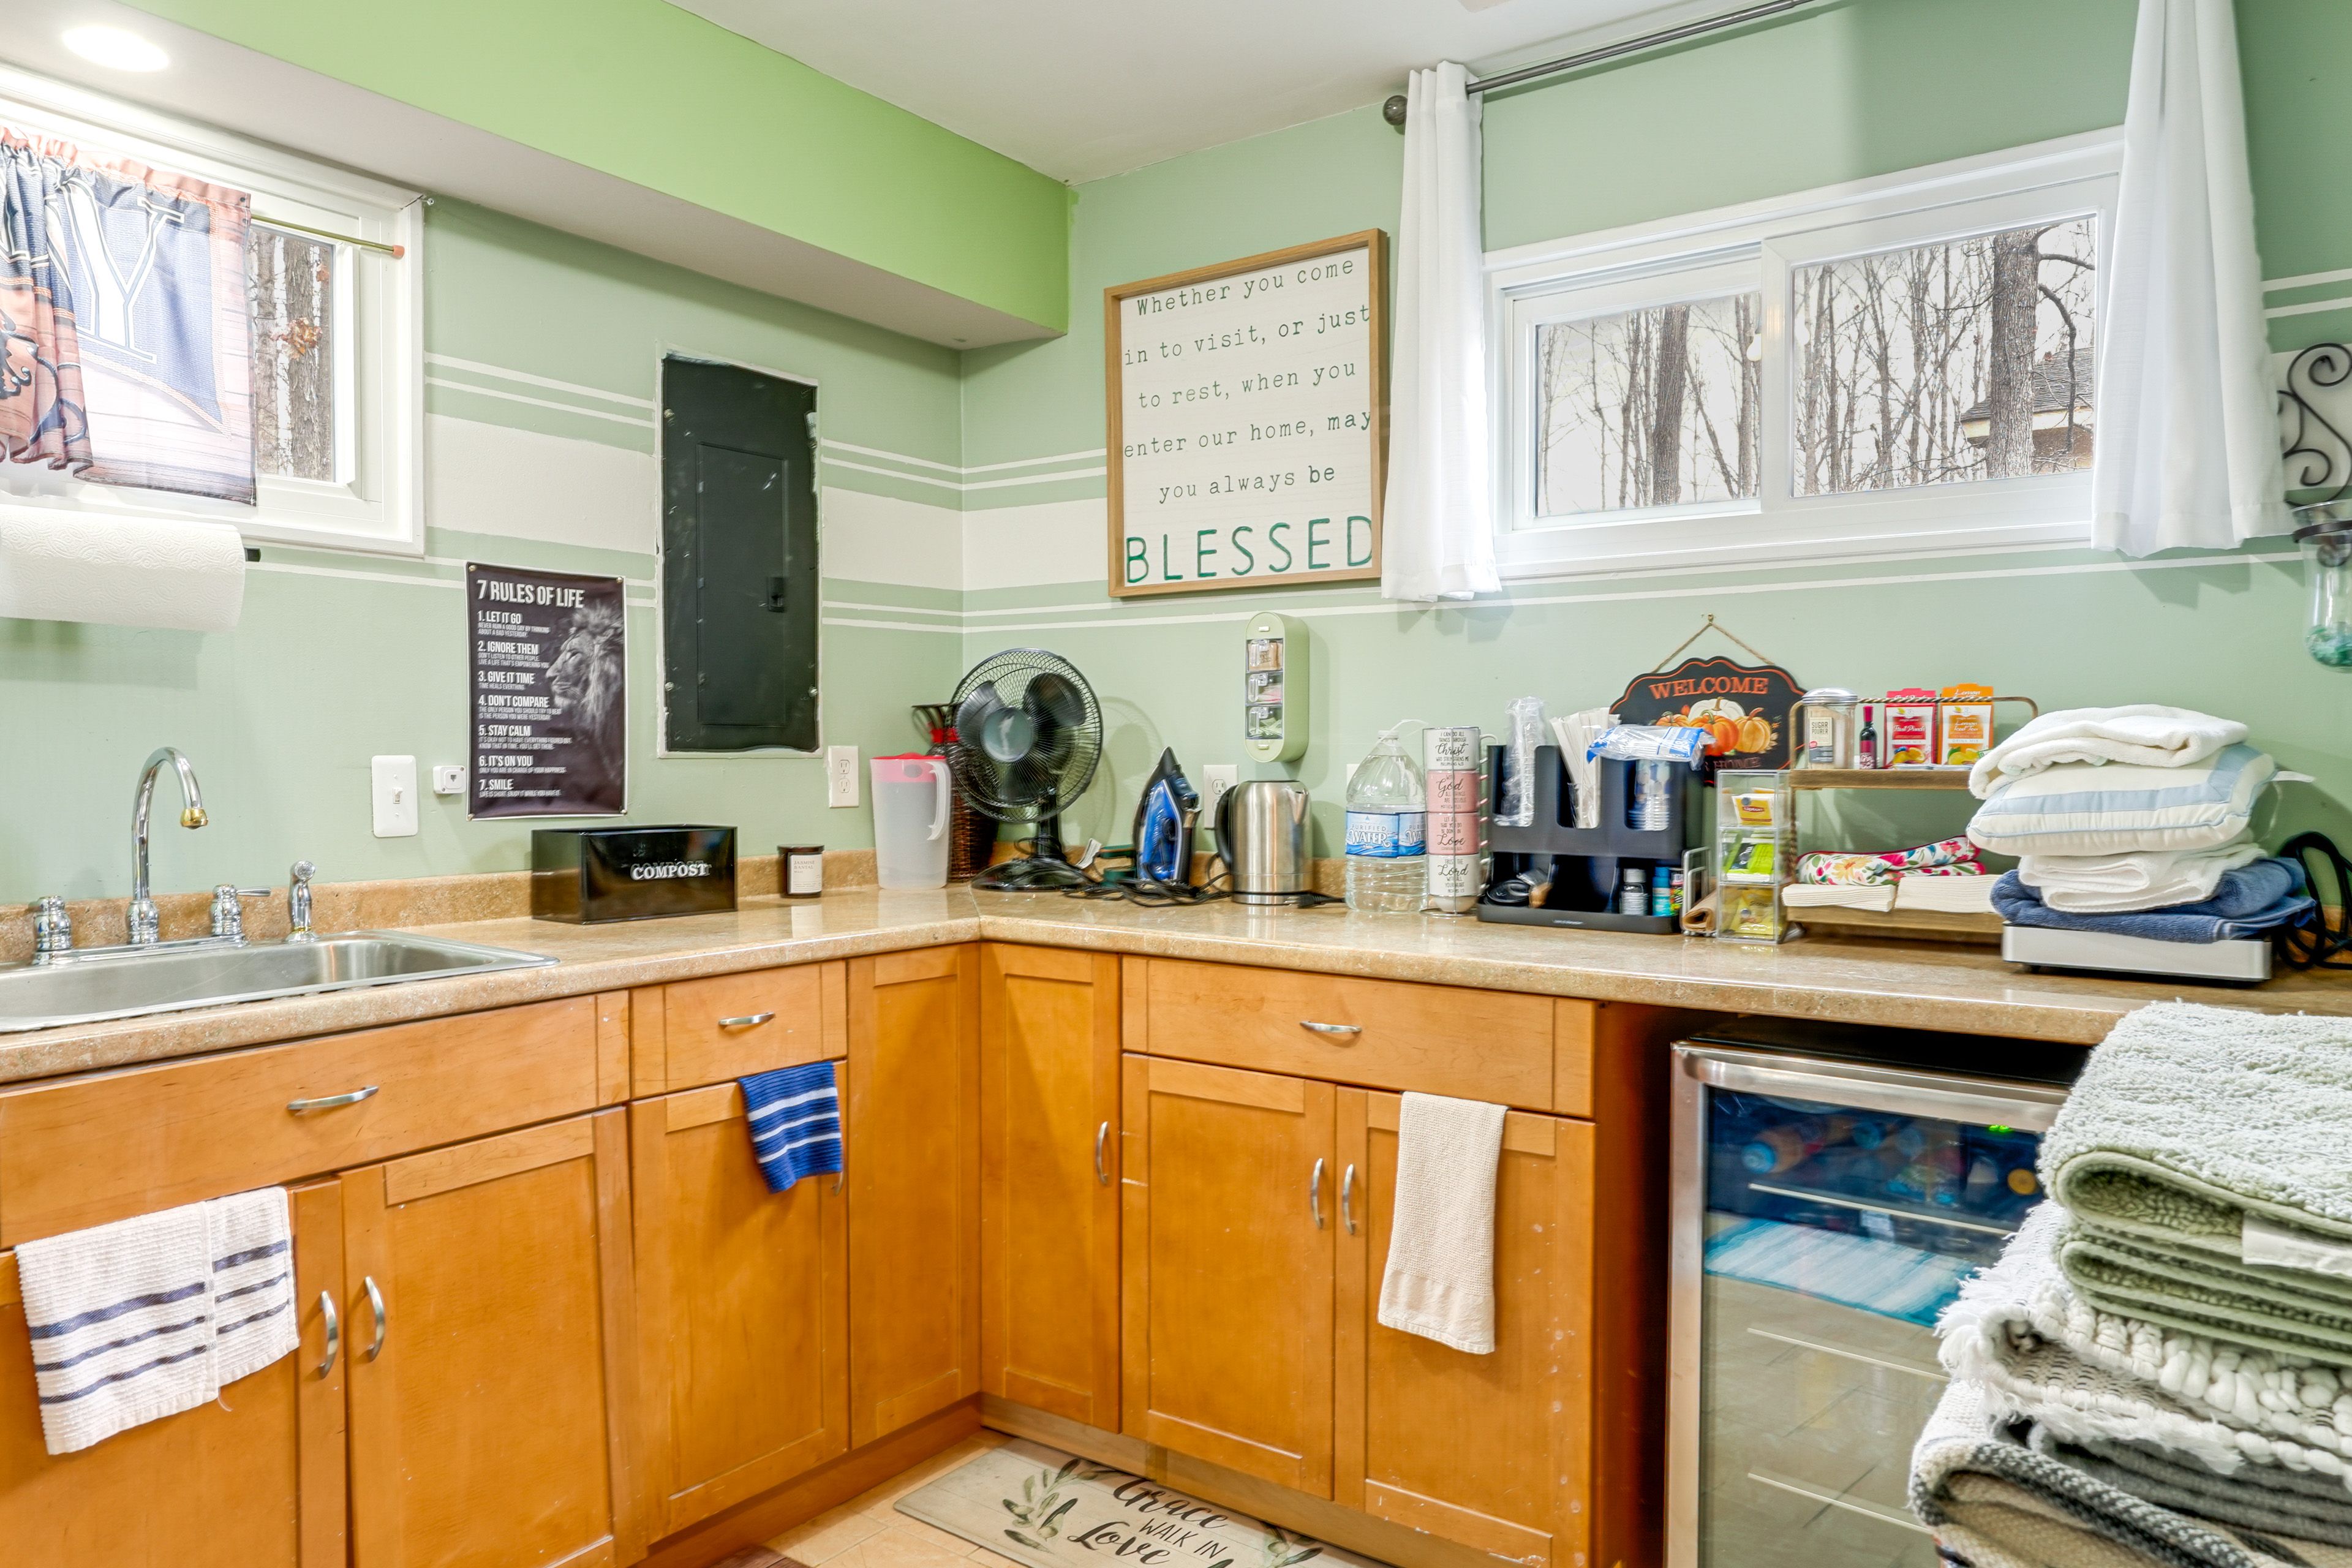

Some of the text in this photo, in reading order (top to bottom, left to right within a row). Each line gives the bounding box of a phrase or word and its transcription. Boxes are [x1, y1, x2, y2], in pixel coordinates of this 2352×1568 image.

[1137, 260, 1353, 315] Whether you come
[1125, 304, 1370, 365] in to visit, or just
[1139, 361, 1355, 409] to rest, when you
[1125, 411, 1371, 458] enter our home, may
[1159, 465, 1336, 504] you always be
[1126, 516, 1372, 584] BLESSED
[477, 579, 585, 608] 7 RULES OF LIFE
[478, 610, 522, 624] 1. LET IT GO
[478, 641, 540, 655] 2. IGNORE THEM
[478, 671, 536, 684] 3. GIVE IT TIME
[1648, 676, 1770, 699] WELCOME
[478, 695, 550, 708] 4. DON'T COMPARE
[478, 725, 532, 736] 5. STAY CALM
[1435, 743, 1469, 756] Christ
[478, 755, 533, 766] 6. IT'S ON YOU
[478, 779, 514, 790] 7. SMILE
[1436, 778, 1464, 797] God
[1349, 829, 1391, 848] WATER
[631, 863, 709, 881] COMPOST
[1438, 864, 1469, 876] Lord
[1113, 1478, 1228, 1529] Grace
[1067, 1521, 1171, 1564] Love
[1139, 1518, 1228, 1559] WALK IN
